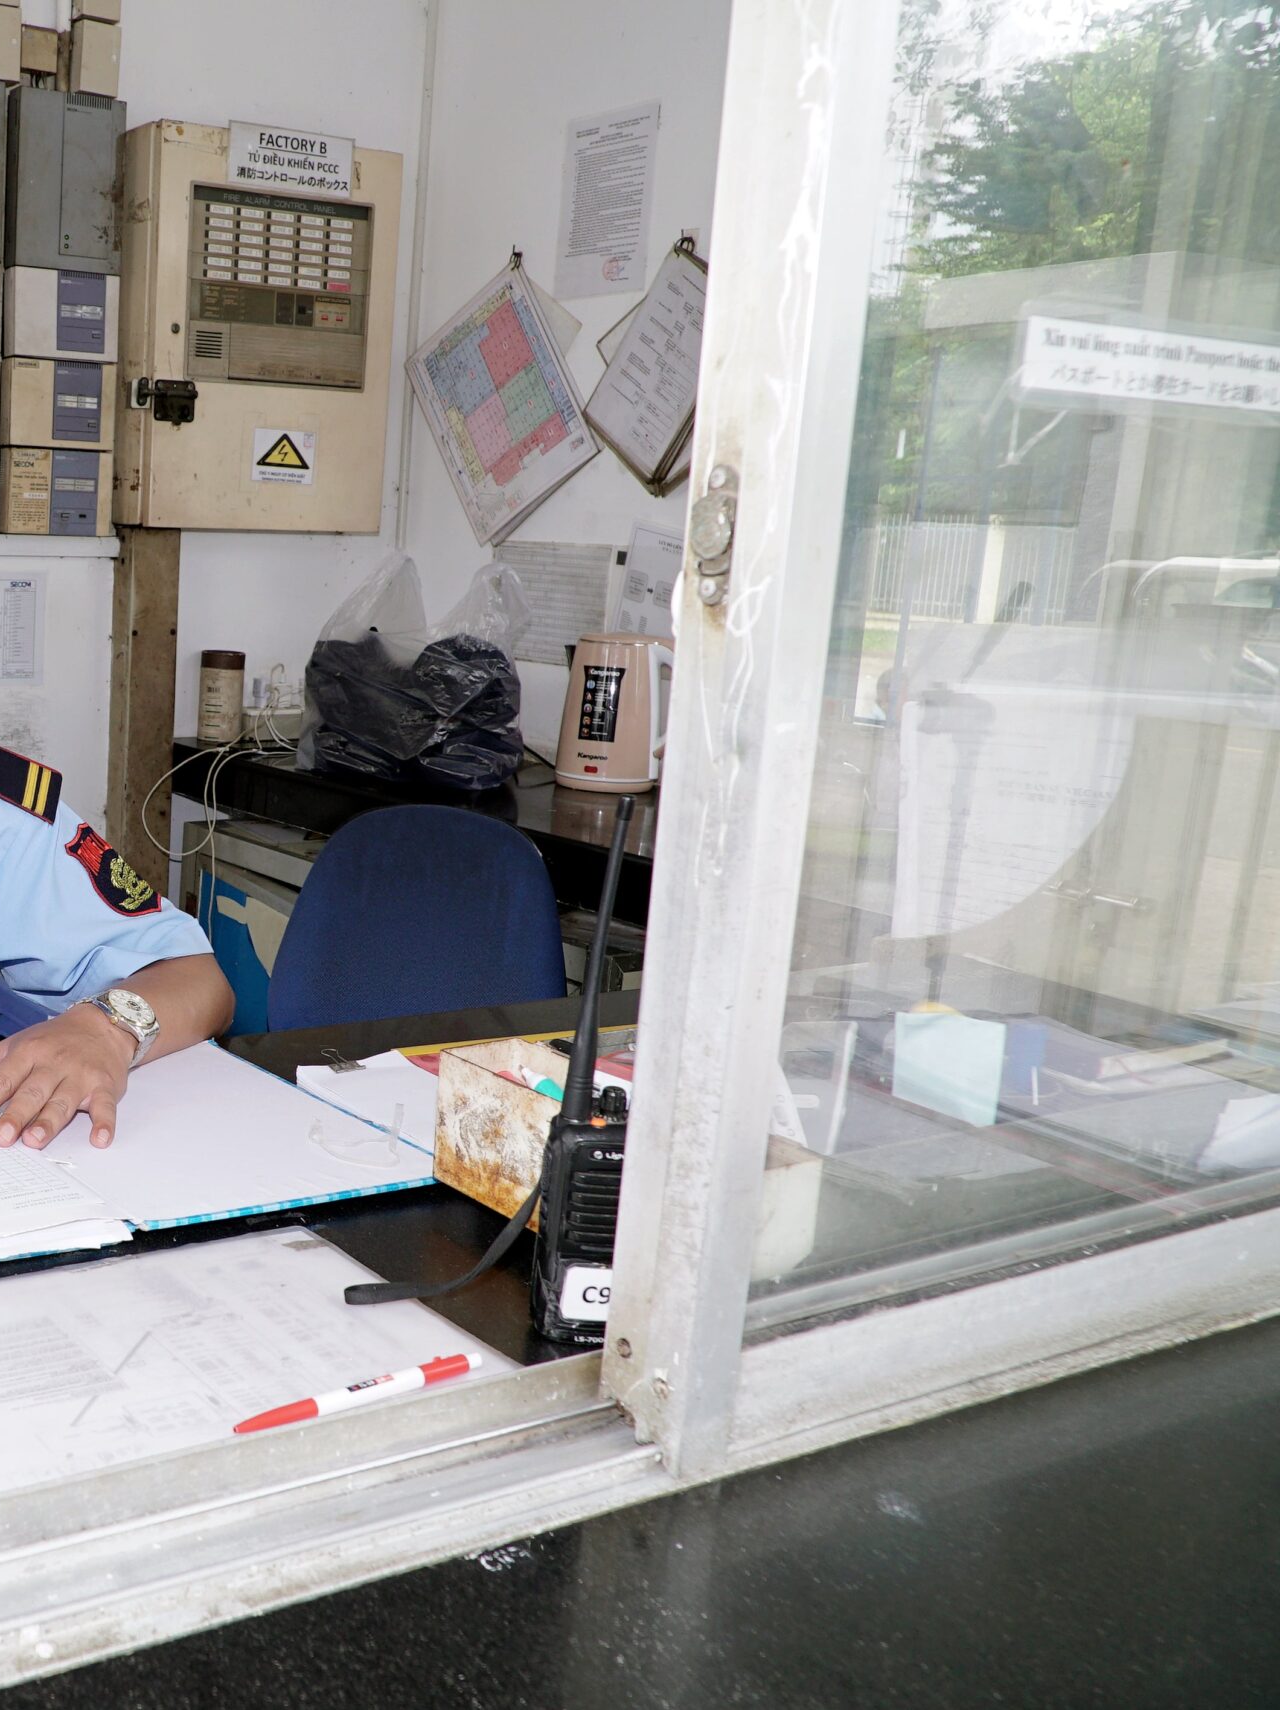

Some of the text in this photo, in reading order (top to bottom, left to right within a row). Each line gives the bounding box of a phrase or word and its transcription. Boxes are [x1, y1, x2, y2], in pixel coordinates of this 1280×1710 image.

[259, 132, 328, 154] FACTORY B
[248, 150, 261, 163] TỦ
[263, 152, 285, 167] ĐIỀU
[317, 162, 339, 174] PCCC
[236, 166, 349, 191] 消防コントロールのボックス
[223, 193, 337, 215] FIRE ALARM CONTROL PANEL
[577, 752, 608, 761] Kangaroo
